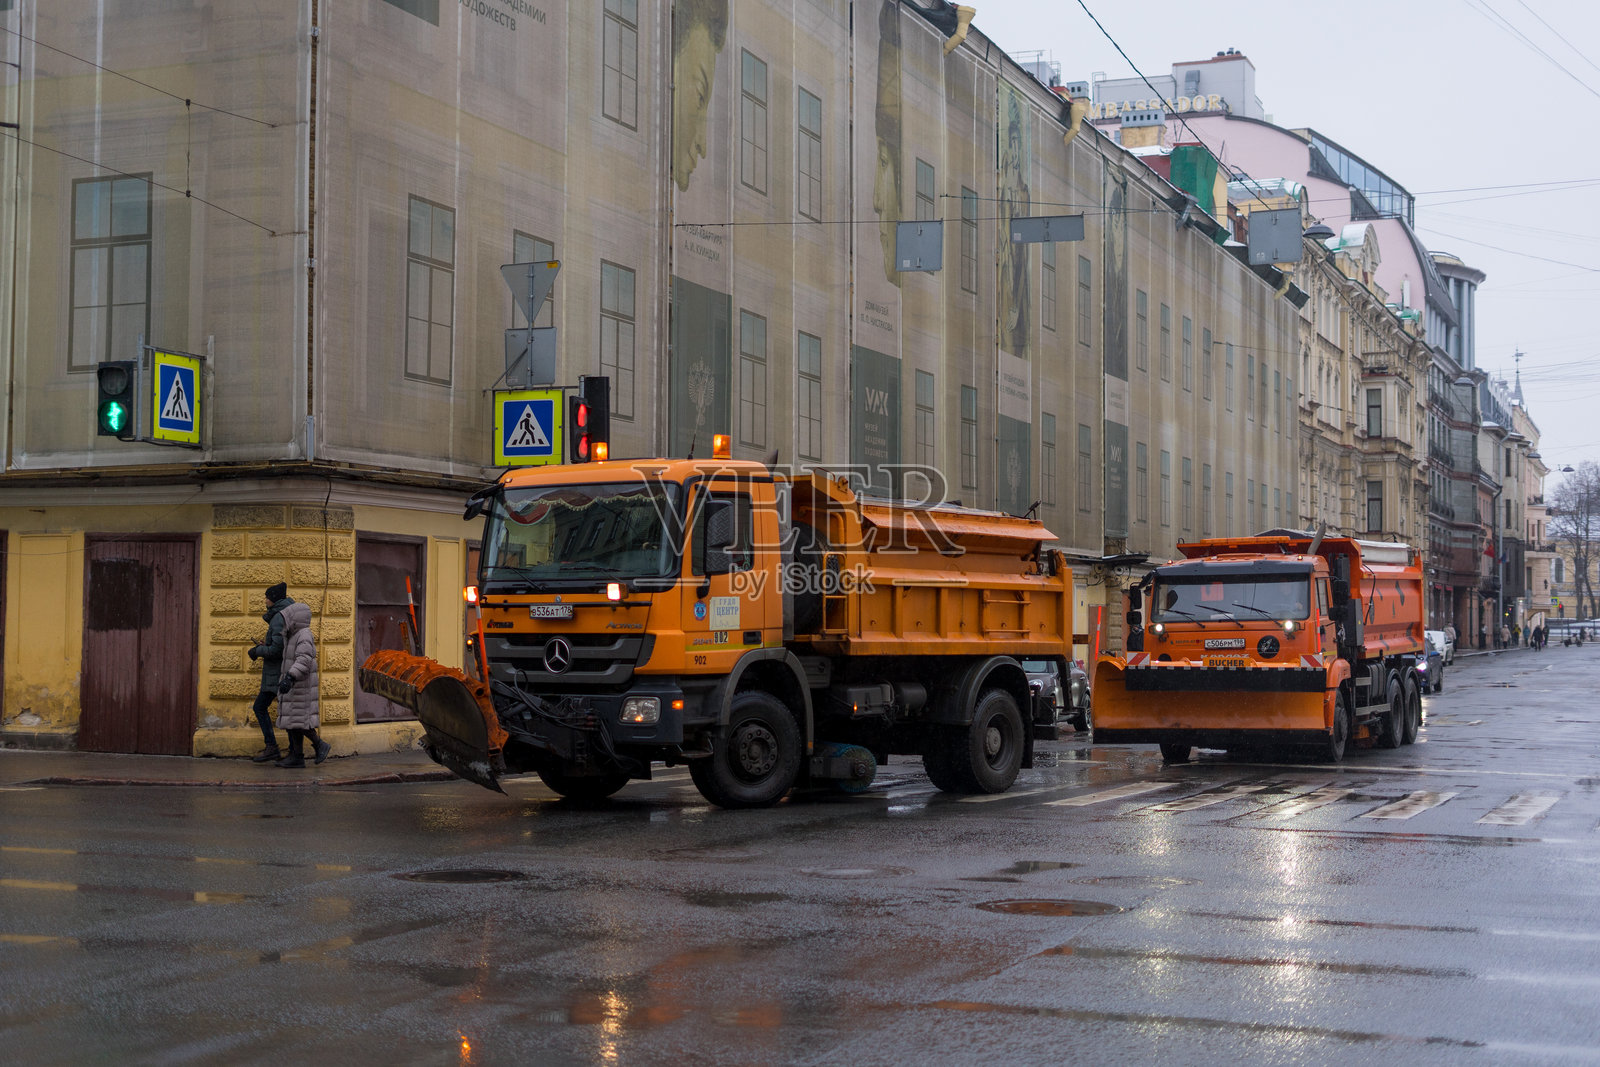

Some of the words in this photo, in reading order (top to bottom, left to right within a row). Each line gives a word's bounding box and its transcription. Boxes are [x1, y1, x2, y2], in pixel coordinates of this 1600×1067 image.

[459, 0, 516, 31] УДОЖЕСТВ
[716, 606, 739, 617] ЦЕНТР
[694, 655, 707, 665] 902
[1208, 659, 1245, 667] BUCHER
